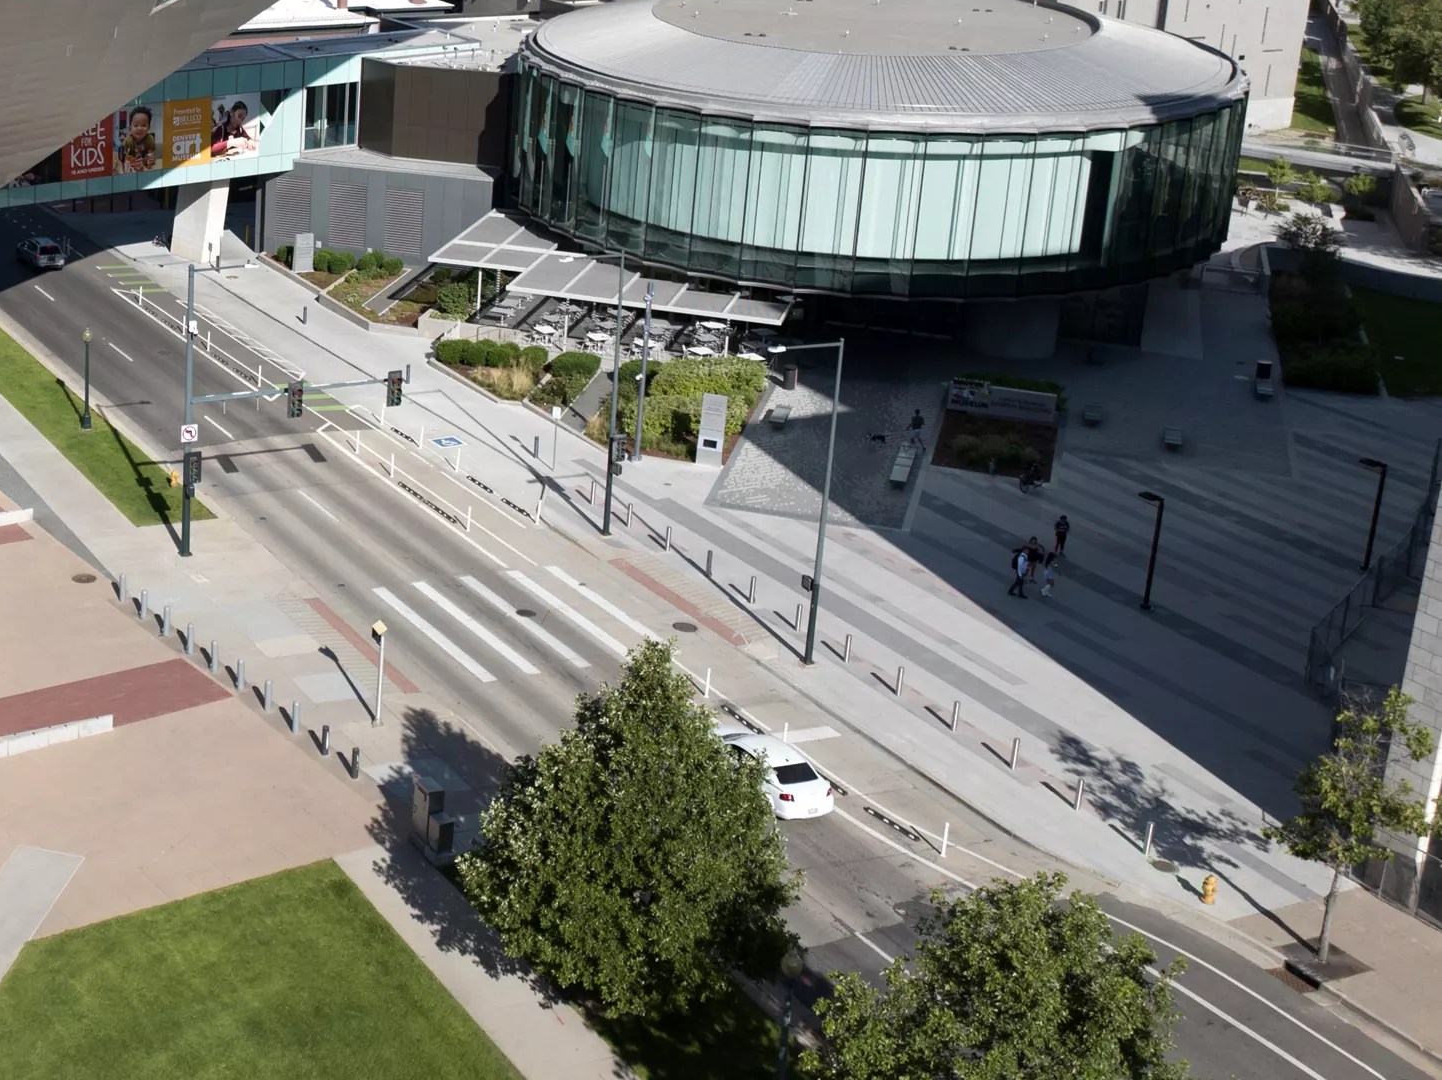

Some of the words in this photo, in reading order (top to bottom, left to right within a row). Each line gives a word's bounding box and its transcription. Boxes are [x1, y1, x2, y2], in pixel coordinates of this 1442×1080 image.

[81, 137, 93, 147] FOR
[172, 133, 196, 142] DENVER
[172, 133, 202, 155] art
[70, 141, 106, 168] KIDS
[172, 152, 201, 162] MUSEUM
